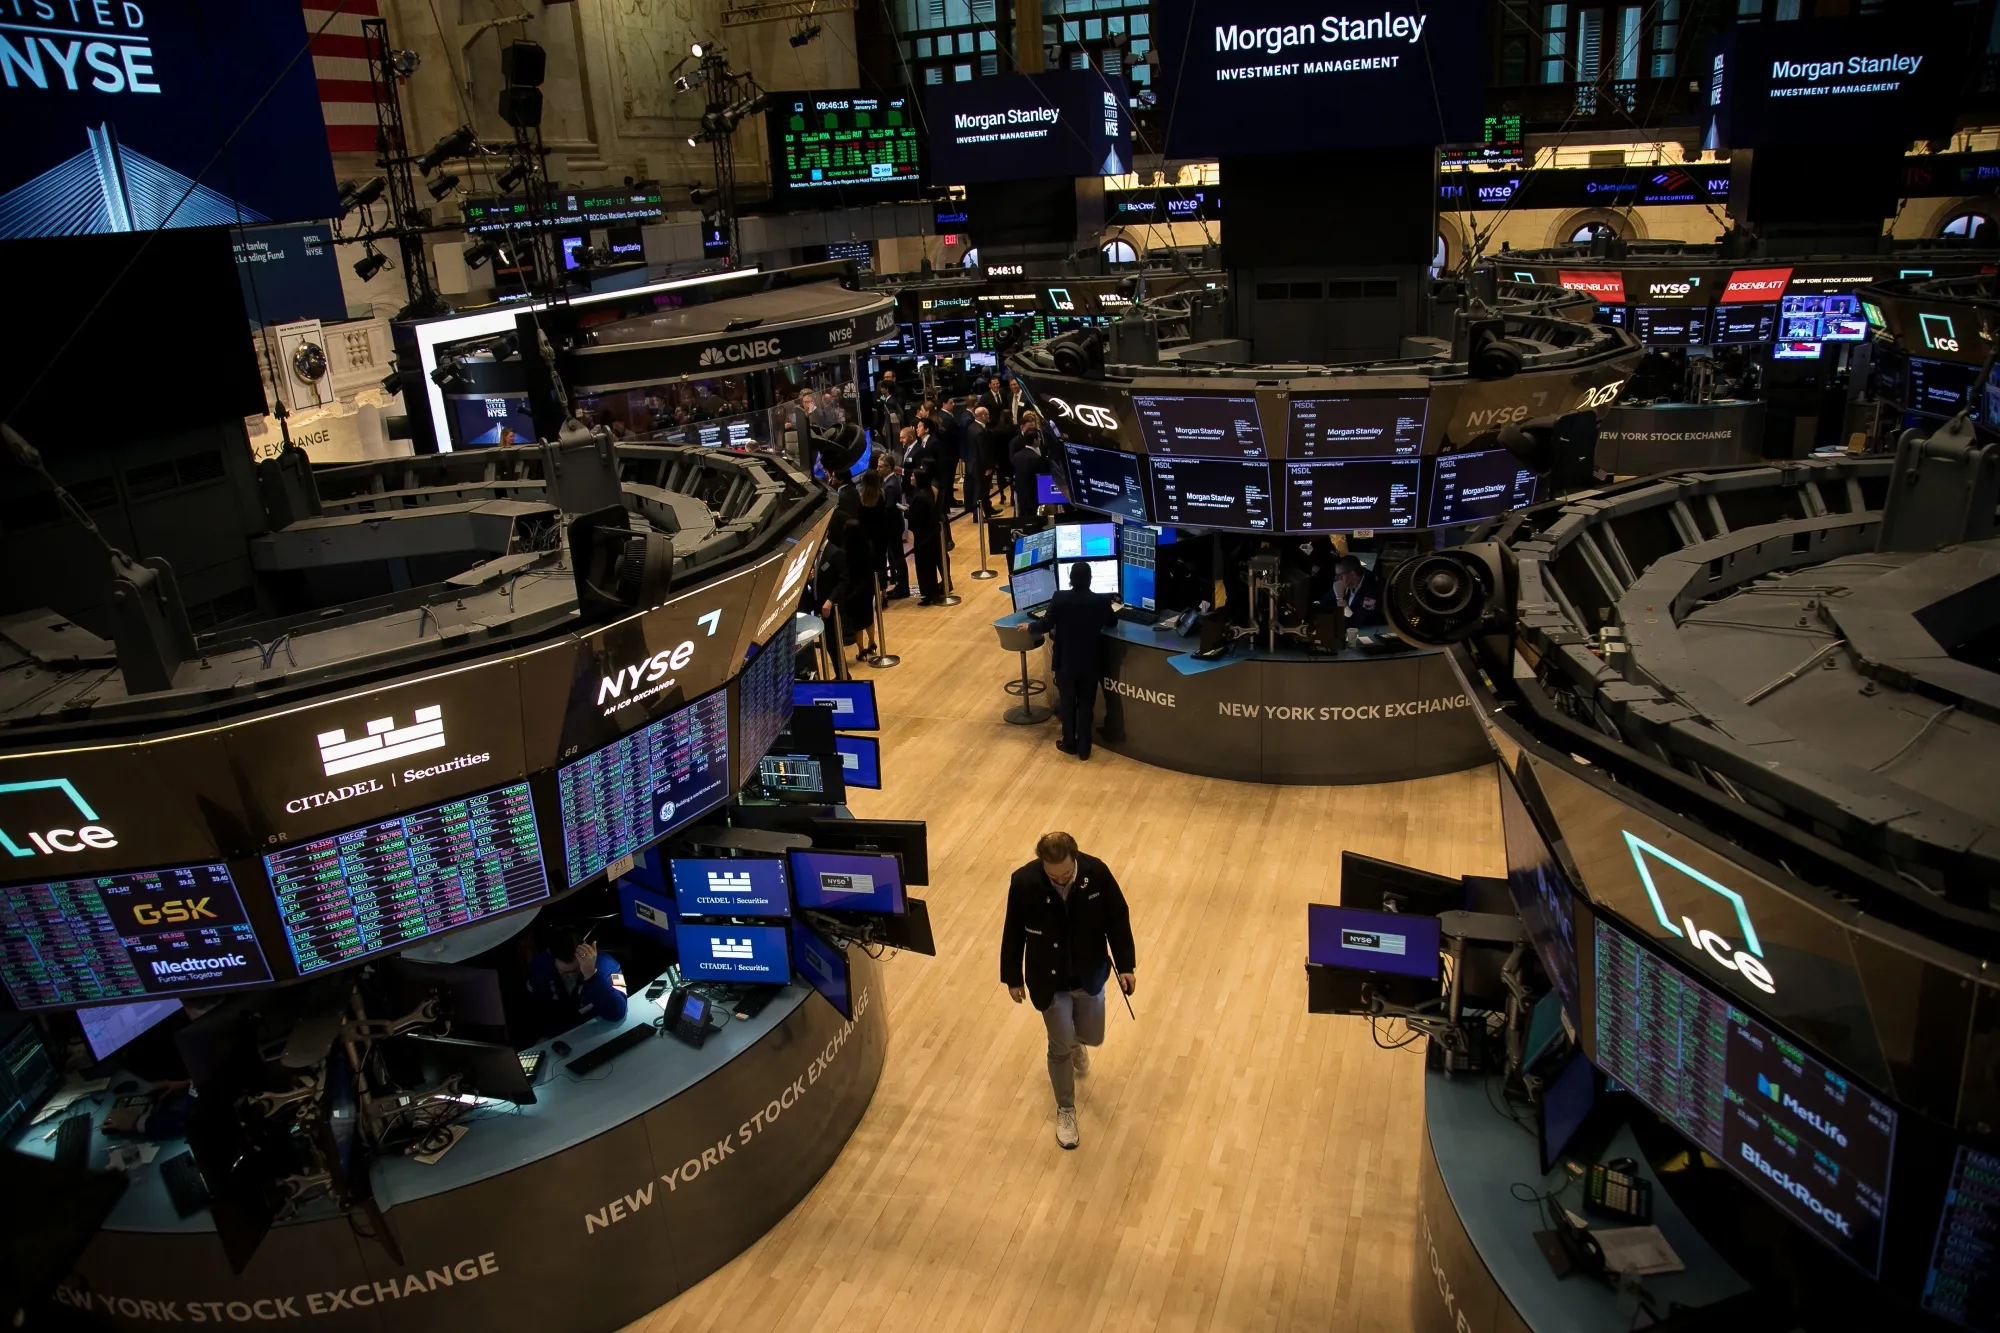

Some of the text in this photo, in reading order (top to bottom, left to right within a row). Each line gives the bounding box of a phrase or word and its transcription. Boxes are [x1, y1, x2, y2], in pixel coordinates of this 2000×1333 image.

[0, 0, 143, 28] ISTED
[1215, 12, 1427, 54] Morgan Stanley
[0, 34, 161, 93] NYSE
[1216, 56, 1399, 81] INVESTMENT MANAGEMENT
[1772, 54, 1922, 81] Morgan Stanley
[1770, 82, 1900, 97] INVESTMENT MANAGEMENT
[1103, 91, 1117, 106] MSDL
[816, 101, 849, 110] 09:46:16
[955, 107, 1059, 130] Morgan Stanley
[1105, 121, 1119, 136] NYSE
[956, 129, 1048, 144] INVESTMENT MANAGEMENT
[303, 235, 321, 243] MSDL
[944, 234, 957, 245] EXIT
[267, 248, 323, 260] Fund NYSE
[988, 265, 1023, 276] 9:46:16
[1563, 282, 1619, 292] ROSENBLATT
[1728, 281, 1784, 291] ROSENBLATT
[725, 338, 781, 362] CNBC
[1591, 380, 1624, 407] GTS
[487, 409, 508, 417] NYSE
[1074, 404, 1118, 430] GTS
[1175, 427, 1225, 437] Morgan Stanley
[1355, 427, 1383, 435] Stanley
[1621, 432, 1648, 441] YORK
[1650, 432, 1683, 441] STOCK
[1684, 430, 1732, 441] EXCHANGE
[1439, 460, 1456, 469] MSDL
[1090, 478, 1120, 492] Morgan Stanley
[1462, 484, 1506, 496] Morgan Stanley
[1186, 493, 1235, 503] Morgan Stanley
[1324, 496, 1378, 505] Morgan Stanley
[604, 705, 616, 717] AN
[633, 678, 676, 703] EXCHANGE
[1103, 677, 1176, 708] EXCHANGE
[1218, 701, 1260, 718] NEW
[1264, 705, 1315, 721] YORK
[1319, 705, 1380, 721] STOCK
[286, 752, 491, 814] CITADEL Securities
[469, 796, 489, 806] SCCO
[405, 816, 417, 824] NX
[474, 816, 490, 825] WPC
[268, 832, 287, 844] 6R
[341, 842, 365, 853] MODN
[413, 843, 431, 854] PFGC
[418, 862, 438, 873] PLOW
[97, 877, 114, 886] GSK
[280, 882, 298, 892] JELD
[355, 892, 376, 902] NEXA
[737, 897, 769, 905] Securities
[133, 896, 218, 926] GSK
[300, 950, 317, 960] MAN
[151, 953, 247, 975] Medtronic
[699, 962, 770, 972] CITADEL Securities
[157, 971, 223, 983] Further, Together
[1732, 1009, 1749, 1028] MET
[585, 986, 869, 1235] NEW YORK STOCK EXCHANGE
[1783, 1093, 1849, 1148] MetLife
[1741, 1141, 1851, 1236] BlackRock
[54, 1252, 500, 1323] EW YORK STOCK EXCHANGE
